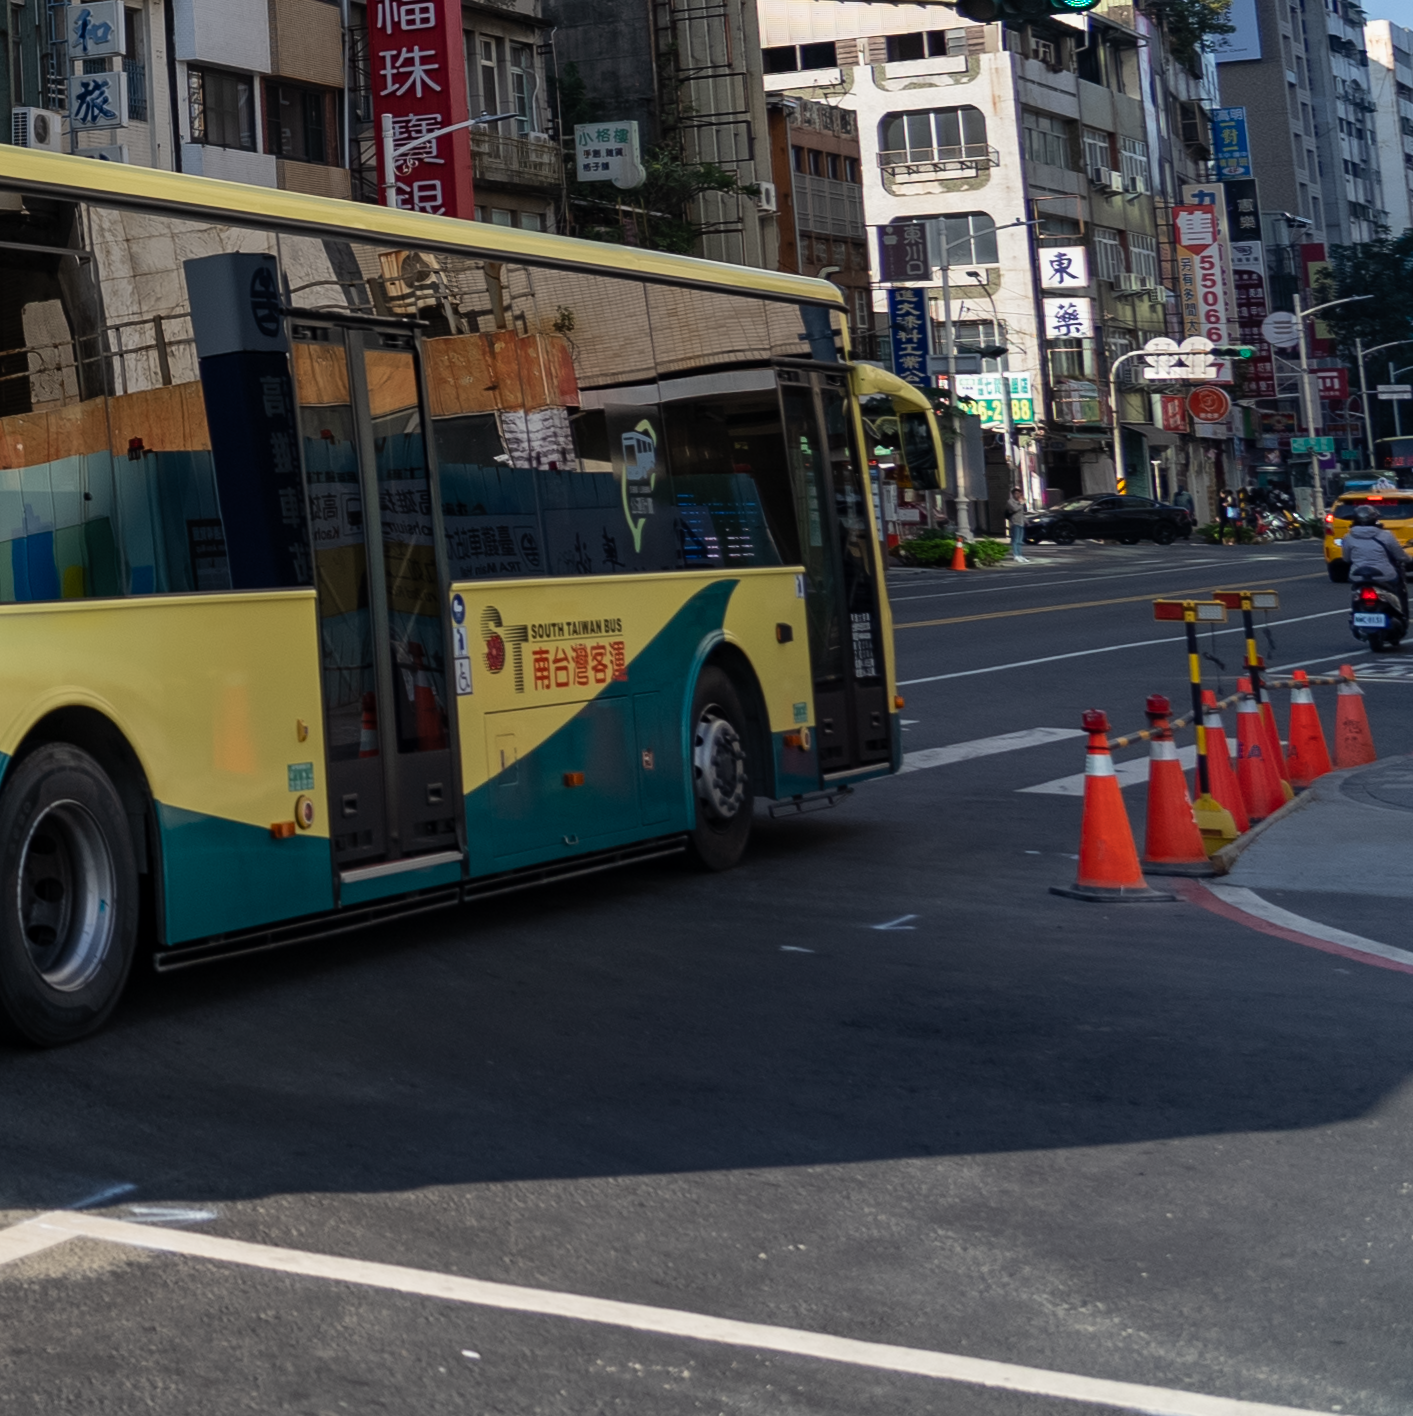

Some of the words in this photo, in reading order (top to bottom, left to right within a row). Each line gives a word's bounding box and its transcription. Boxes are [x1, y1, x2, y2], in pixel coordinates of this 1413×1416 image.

[578, 127, 630, 147] 小格樓
[1176, 210, 1216, 246] 售
[903, 225, 924, 276] 東川口
[1048, 251, 1080, 284] 東
[1054, 303, 1091, 336] 藥
[531, 623, 564, 639] SOUTH
[565, 620, 602, 637] TAIWAN
[604, 617, 623, 633] BUS
[531, 640, 628, 691] 南台灣客運
